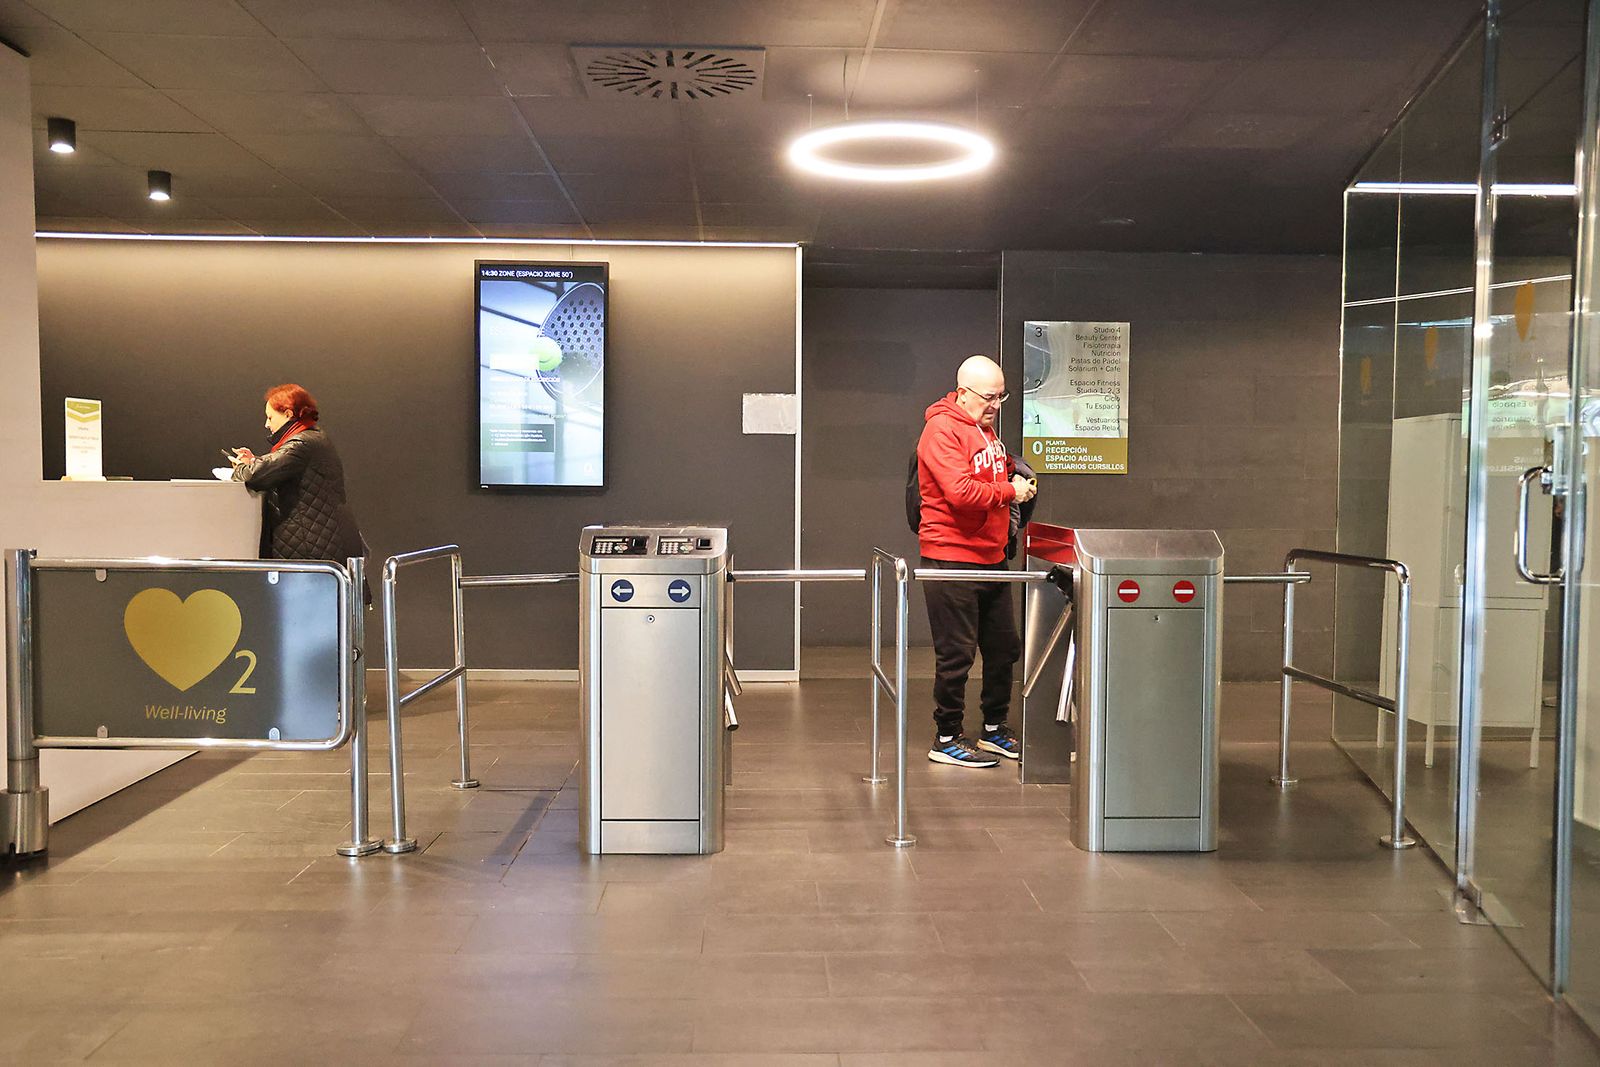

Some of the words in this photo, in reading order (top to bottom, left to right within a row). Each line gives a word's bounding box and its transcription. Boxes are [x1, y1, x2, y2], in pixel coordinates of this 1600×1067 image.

[1035, 327, 1042, 338] 3
[1035, 379, 1042, 388] 2
[1035, 414, 1042, 424] 1
[1032, 440, 1044, 455] 0
[228, 649, 258, 694] 2
[144, 705, 228, 723] Well-living
